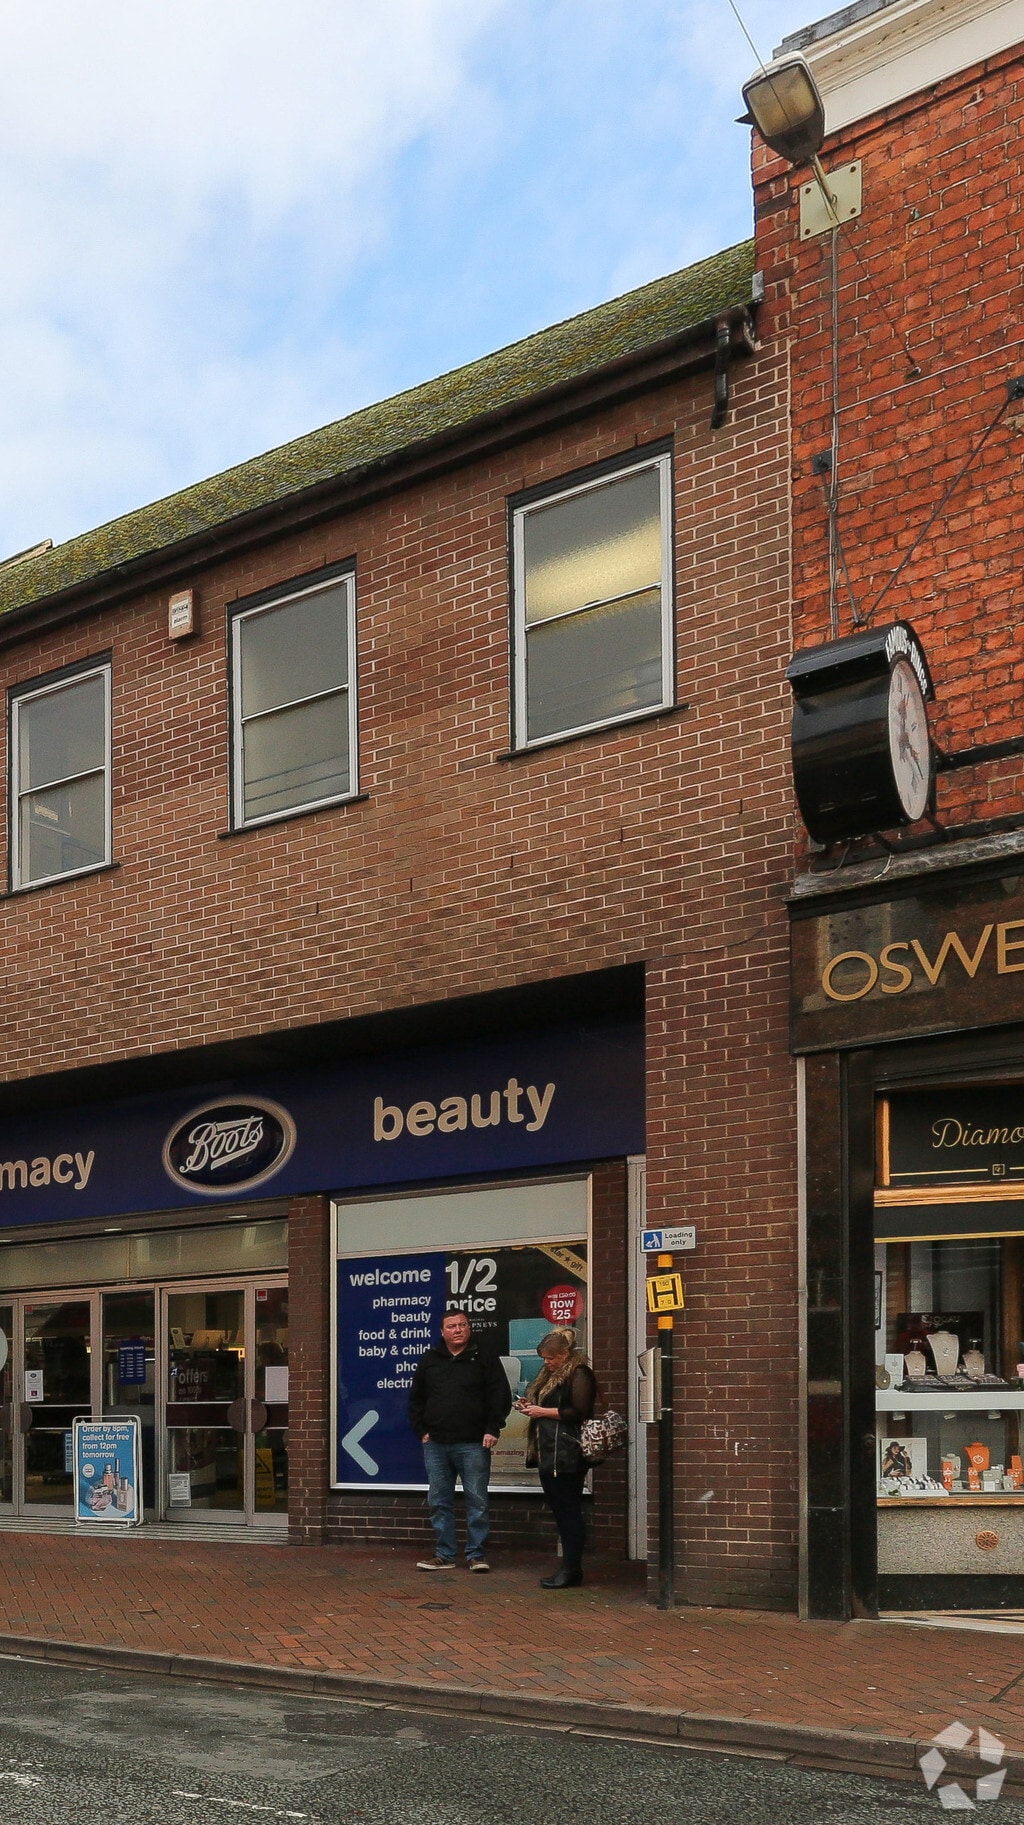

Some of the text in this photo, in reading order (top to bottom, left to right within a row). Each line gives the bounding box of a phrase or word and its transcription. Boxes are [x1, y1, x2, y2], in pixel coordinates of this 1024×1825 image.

[821, 919, 1024, 1002] OSWE
[373, 1077, 556, 1142] beauty
[931, 1118, 1024, 1148] Diamo
[179, 1115, 265, 1172] Boots
[664, 1231, 693, 1239] Loading
[549, 1247, 584, 1272] star gift
[350, 1268, 432, 1287] welcome
[445, 1258, 498, 1294] 1/2
[651, 1278, 679, 1309] H
[373, 1294, 432, 1309] pharmacy
[446, 1295, 497, 1314] price
[550, 1300, 575, 1309] now
[391, 1311, 432, 1325] beauty
[552, 1309, 572, 1320] £25
[359, 1327, 431, 1341] food & drink
[359, 1343, 431, 1359] baby & child
[396, 1360, 417, 1374] pho
[178, 1368, 208, 1384] offers
[82, 1425, 102, 1433] Order
[103, 1425, 111, 1434] by
[82, 1432, 130, 1441] collect for free
[82, 1442, 118, 1451] from 12pm
[82, 1451, 115, 1459] tomorrow
